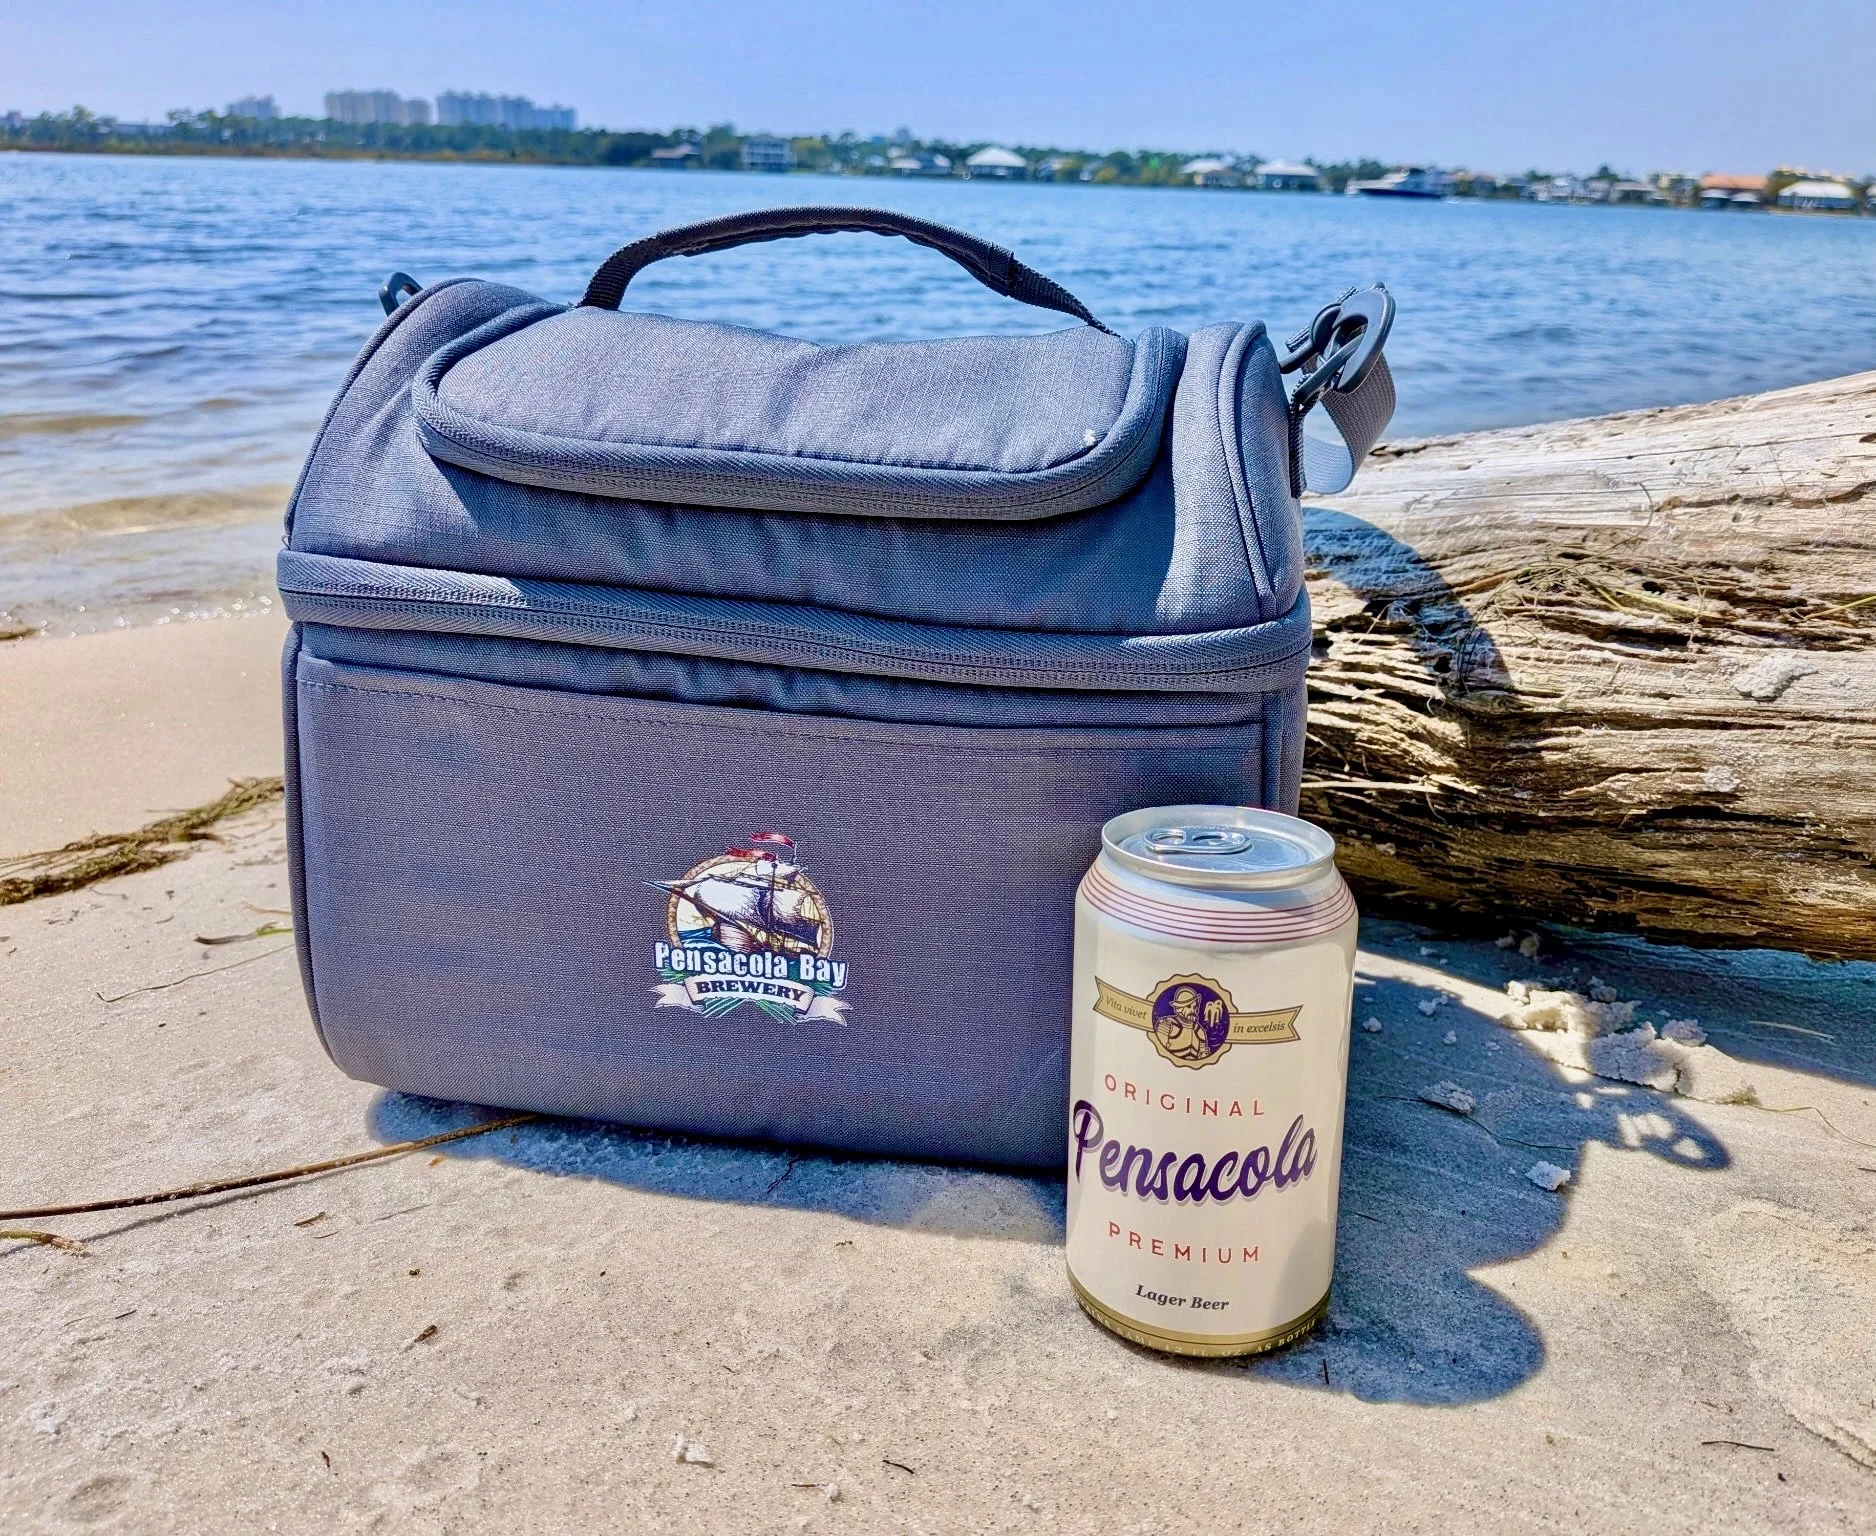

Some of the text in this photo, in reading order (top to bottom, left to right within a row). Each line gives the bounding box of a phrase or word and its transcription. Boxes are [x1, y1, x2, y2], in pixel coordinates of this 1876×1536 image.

[654, 941, 847, 989] Pensacola Bay
[695, 979, 808, 1001] BREWERY
[1105, 995, 1148, 1020] Vita vivet
[1233, 1020, 1286, 1033] in excelsis
[1104, 1073, 1266, 1117] ORIGINAL
[1072, 1099, 1318, 1206] Pensacola
[1107, 1220, 1260, 1264] PREMIUM
[1135, 1283, 1230, 1311] Lager Beer
[1255, 1343, 1273, 1354] AS
